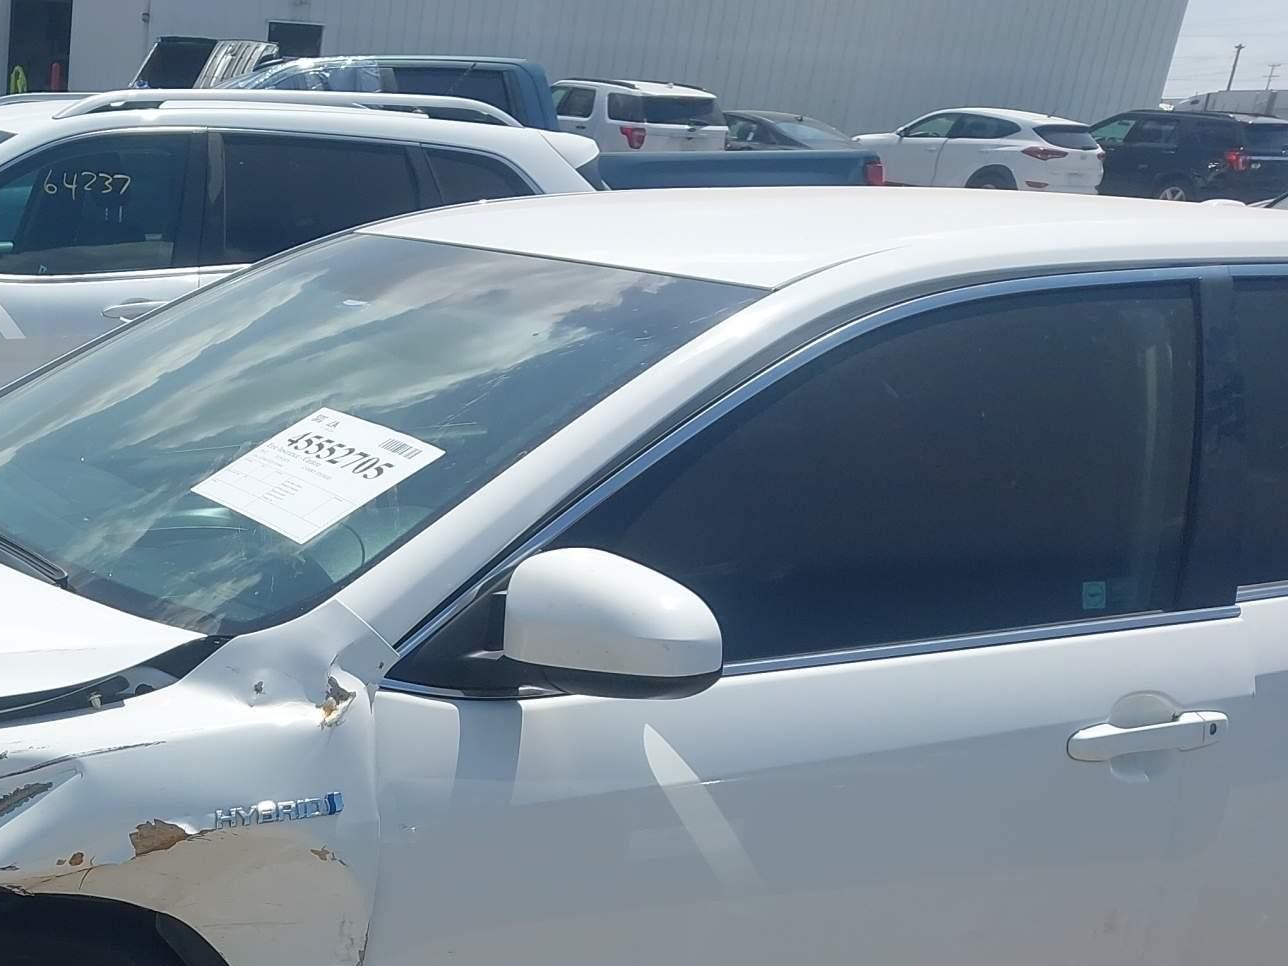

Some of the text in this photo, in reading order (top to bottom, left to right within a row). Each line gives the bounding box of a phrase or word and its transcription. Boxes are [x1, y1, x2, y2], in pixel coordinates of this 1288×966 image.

[43, 169, 132, 200] 64237
[287, 431, 396, 480] 45552705
[214, 797, 325, 829] HYBRID
